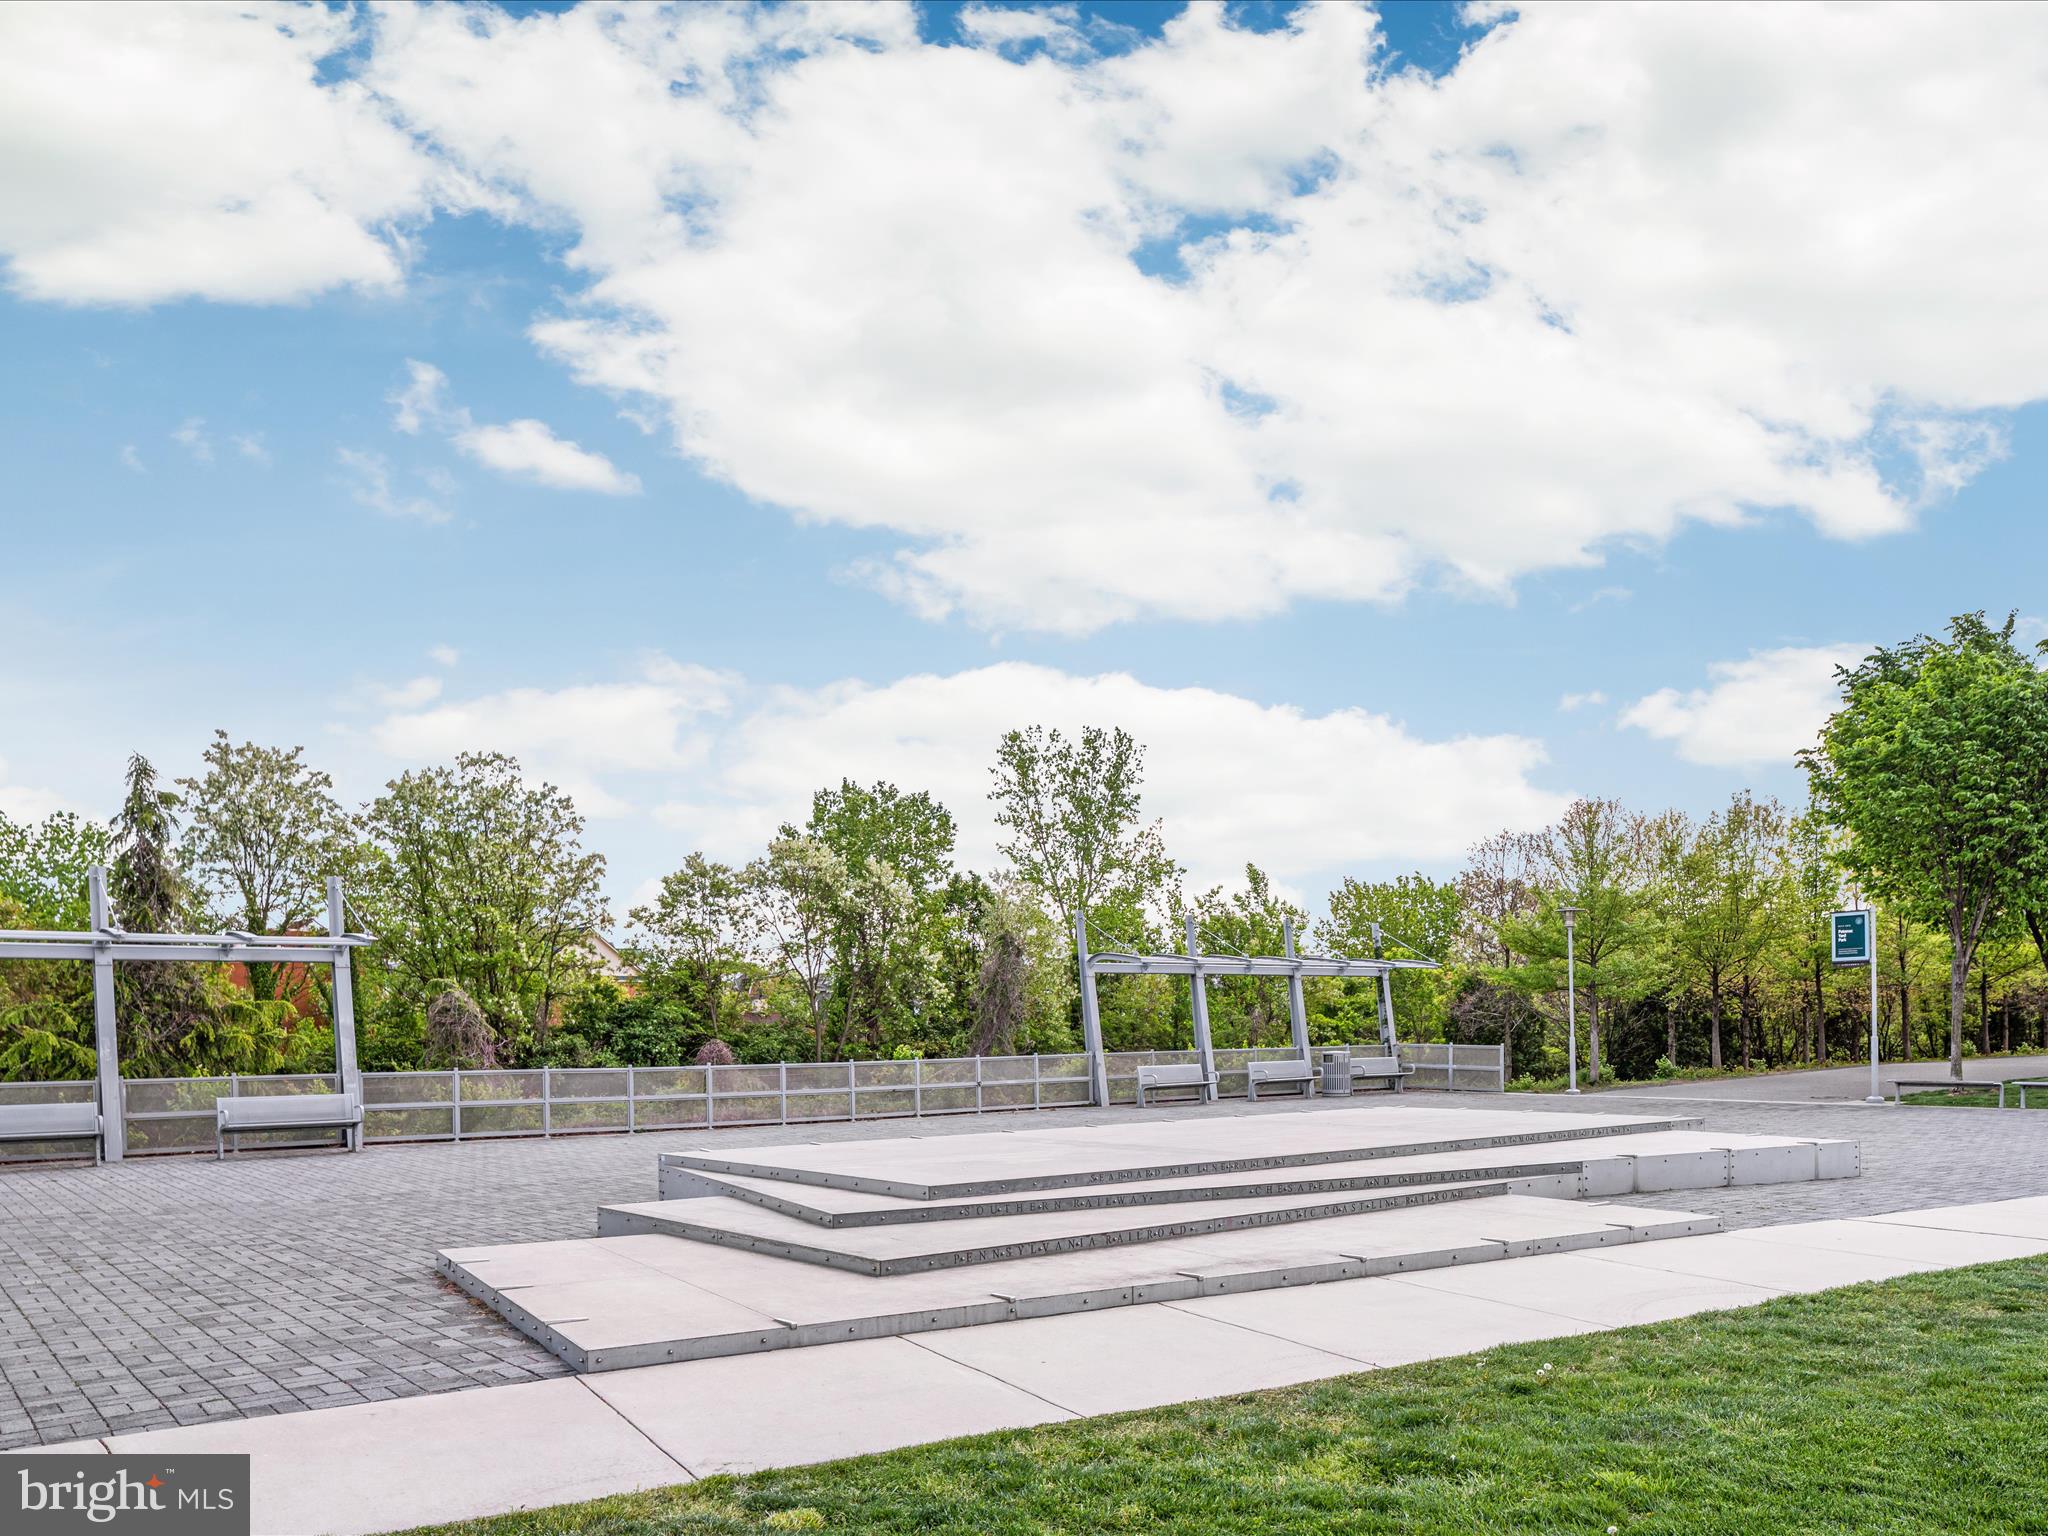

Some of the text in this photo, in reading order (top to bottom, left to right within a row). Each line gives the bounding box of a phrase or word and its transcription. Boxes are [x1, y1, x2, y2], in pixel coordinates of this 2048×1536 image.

[1090, 1156, 1286, 1181] SEABOARD AIR LINE RAILWAY
[1255, 1169, 1500, 1195] CHESAPEAKE AND OHIO RAILWAY
[963, 1194, 1148, 1216] SOUTHERN RAILWAY
[1247, 1189, 1463, 1225] ATLANTIC COAST LINE RAILROAD
[953, 1225, 1186, 1265] PENNSYLVANIA RAILROAD
